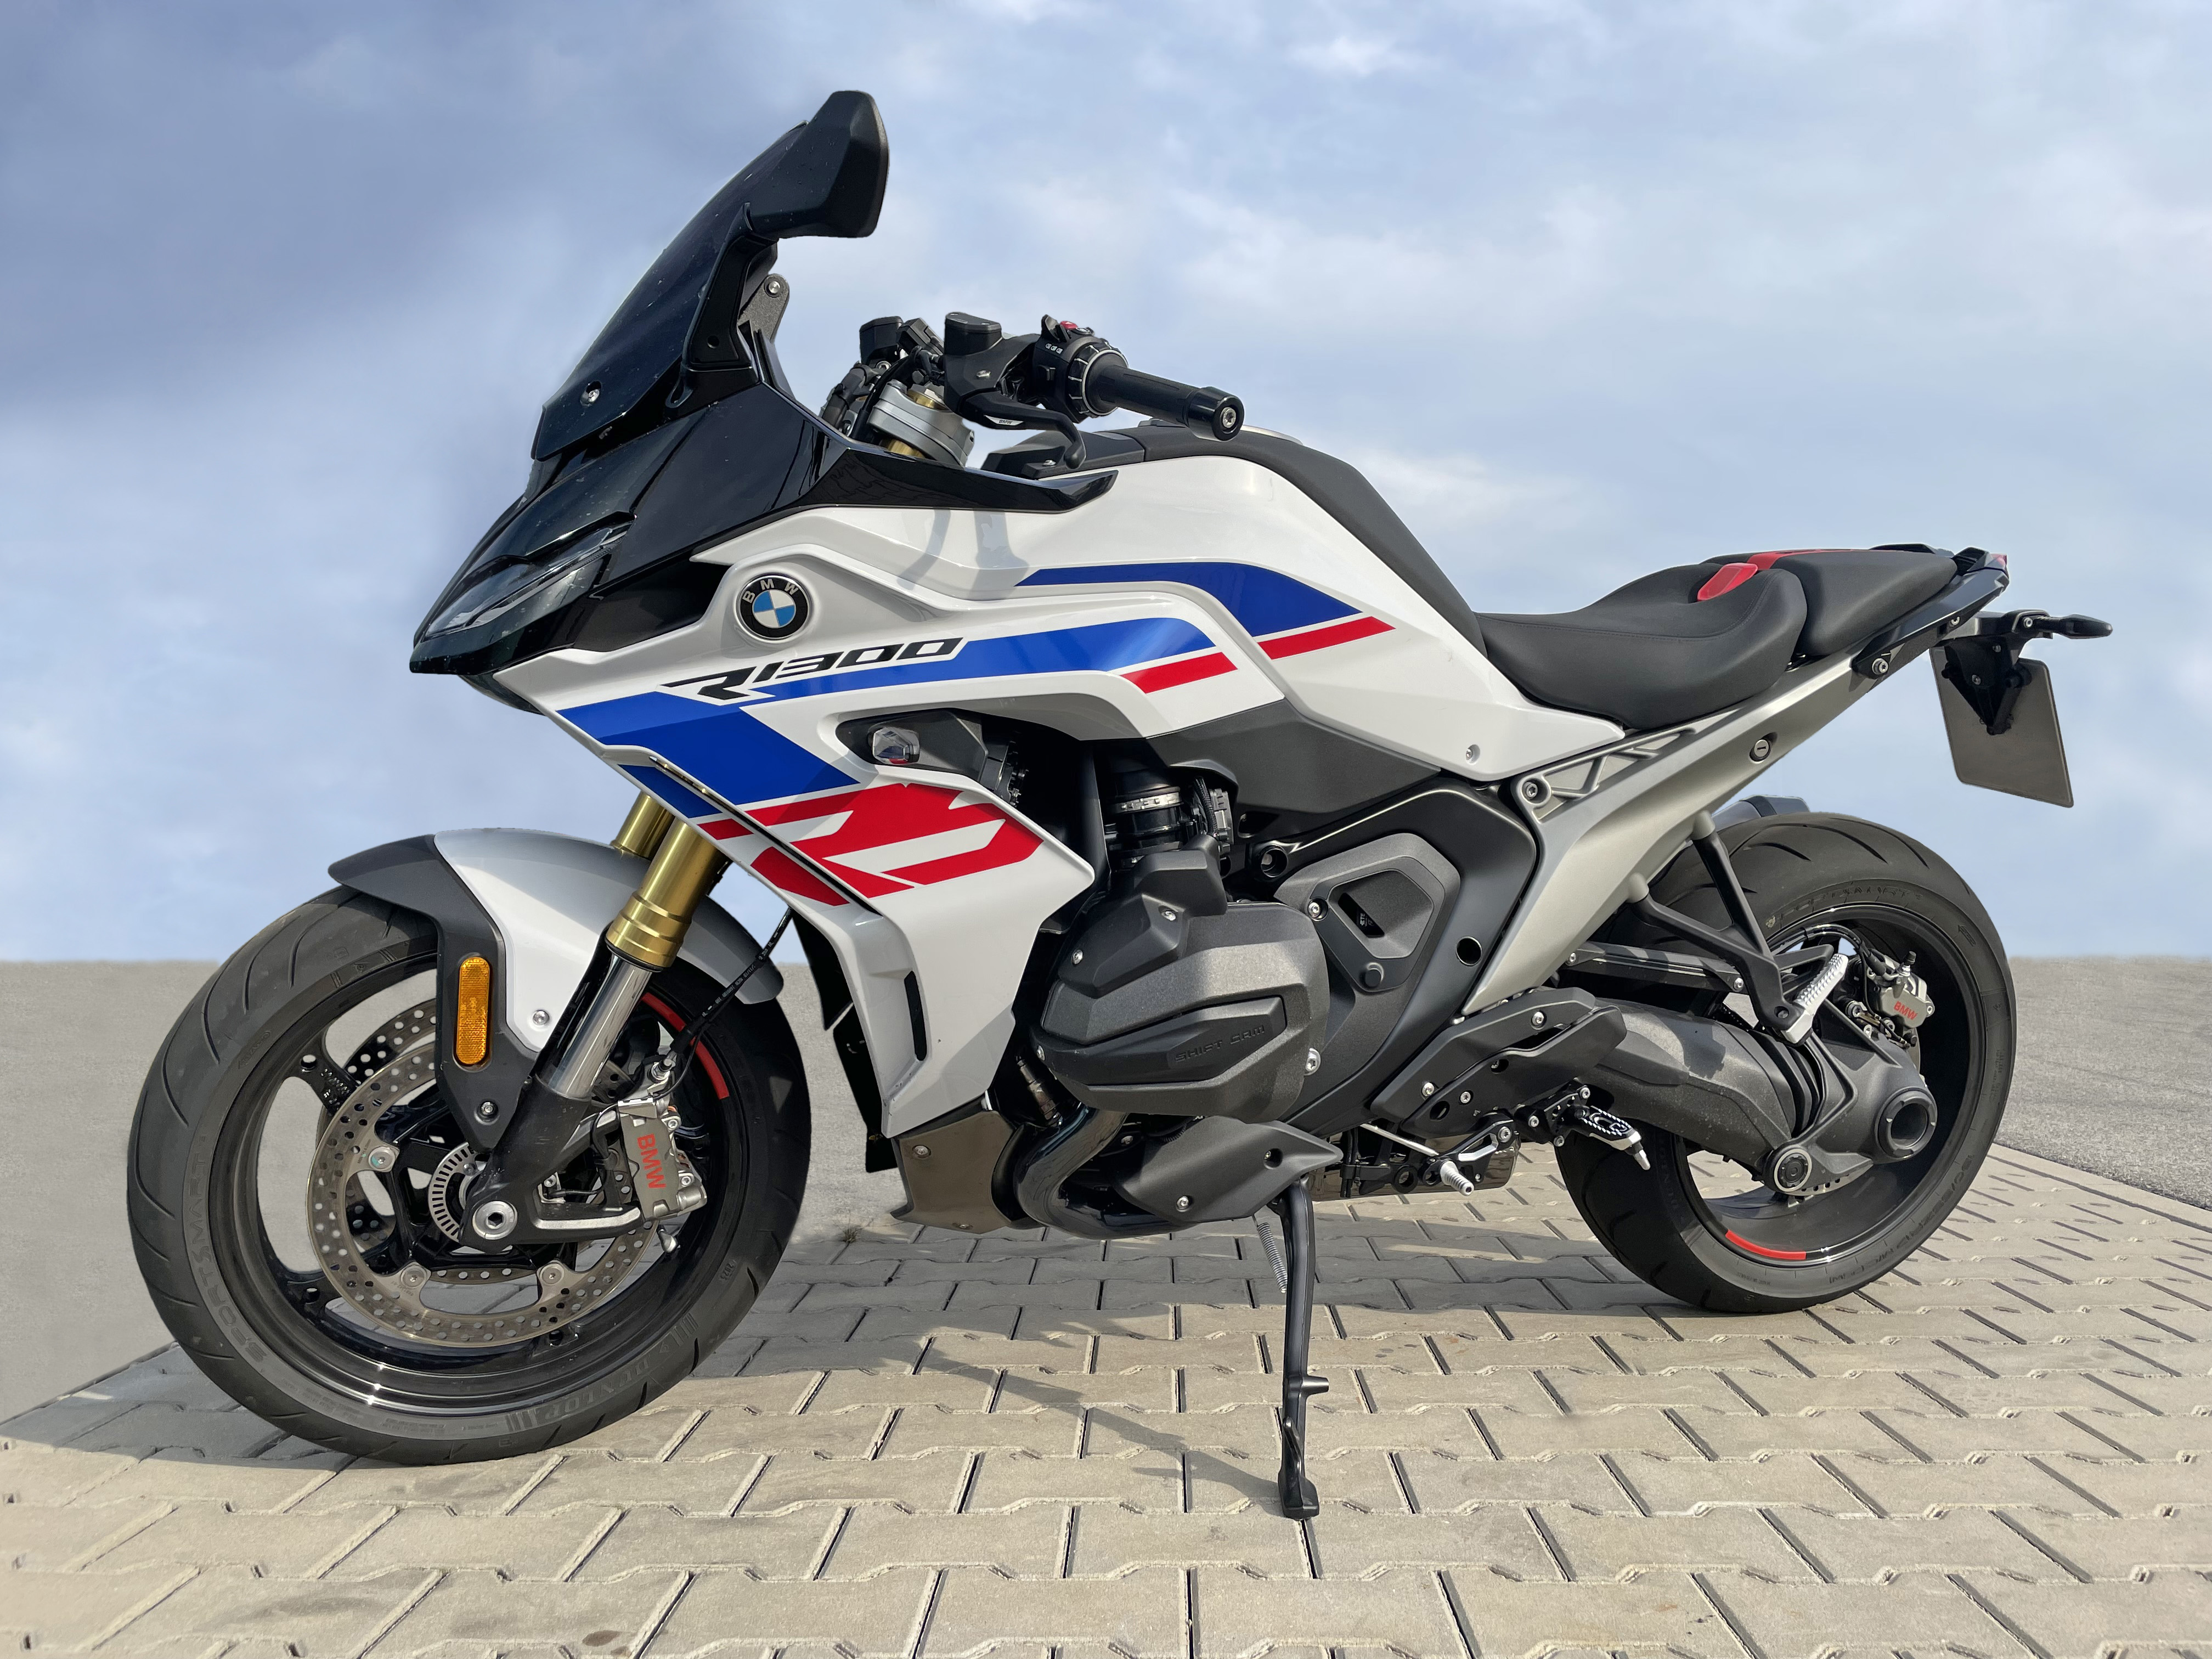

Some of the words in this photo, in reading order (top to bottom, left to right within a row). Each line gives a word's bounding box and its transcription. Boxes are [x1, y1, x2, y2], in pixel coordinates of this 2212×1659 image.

[742, 578, 799, 603] BMW
[1894, 1000, 1918, 1020] BMW
[1175, 1040, 1223, 1063] SHIFT
[1230, 1024, 1265, 1045] CAM
[637, 1133, 667, 1189] BMW
